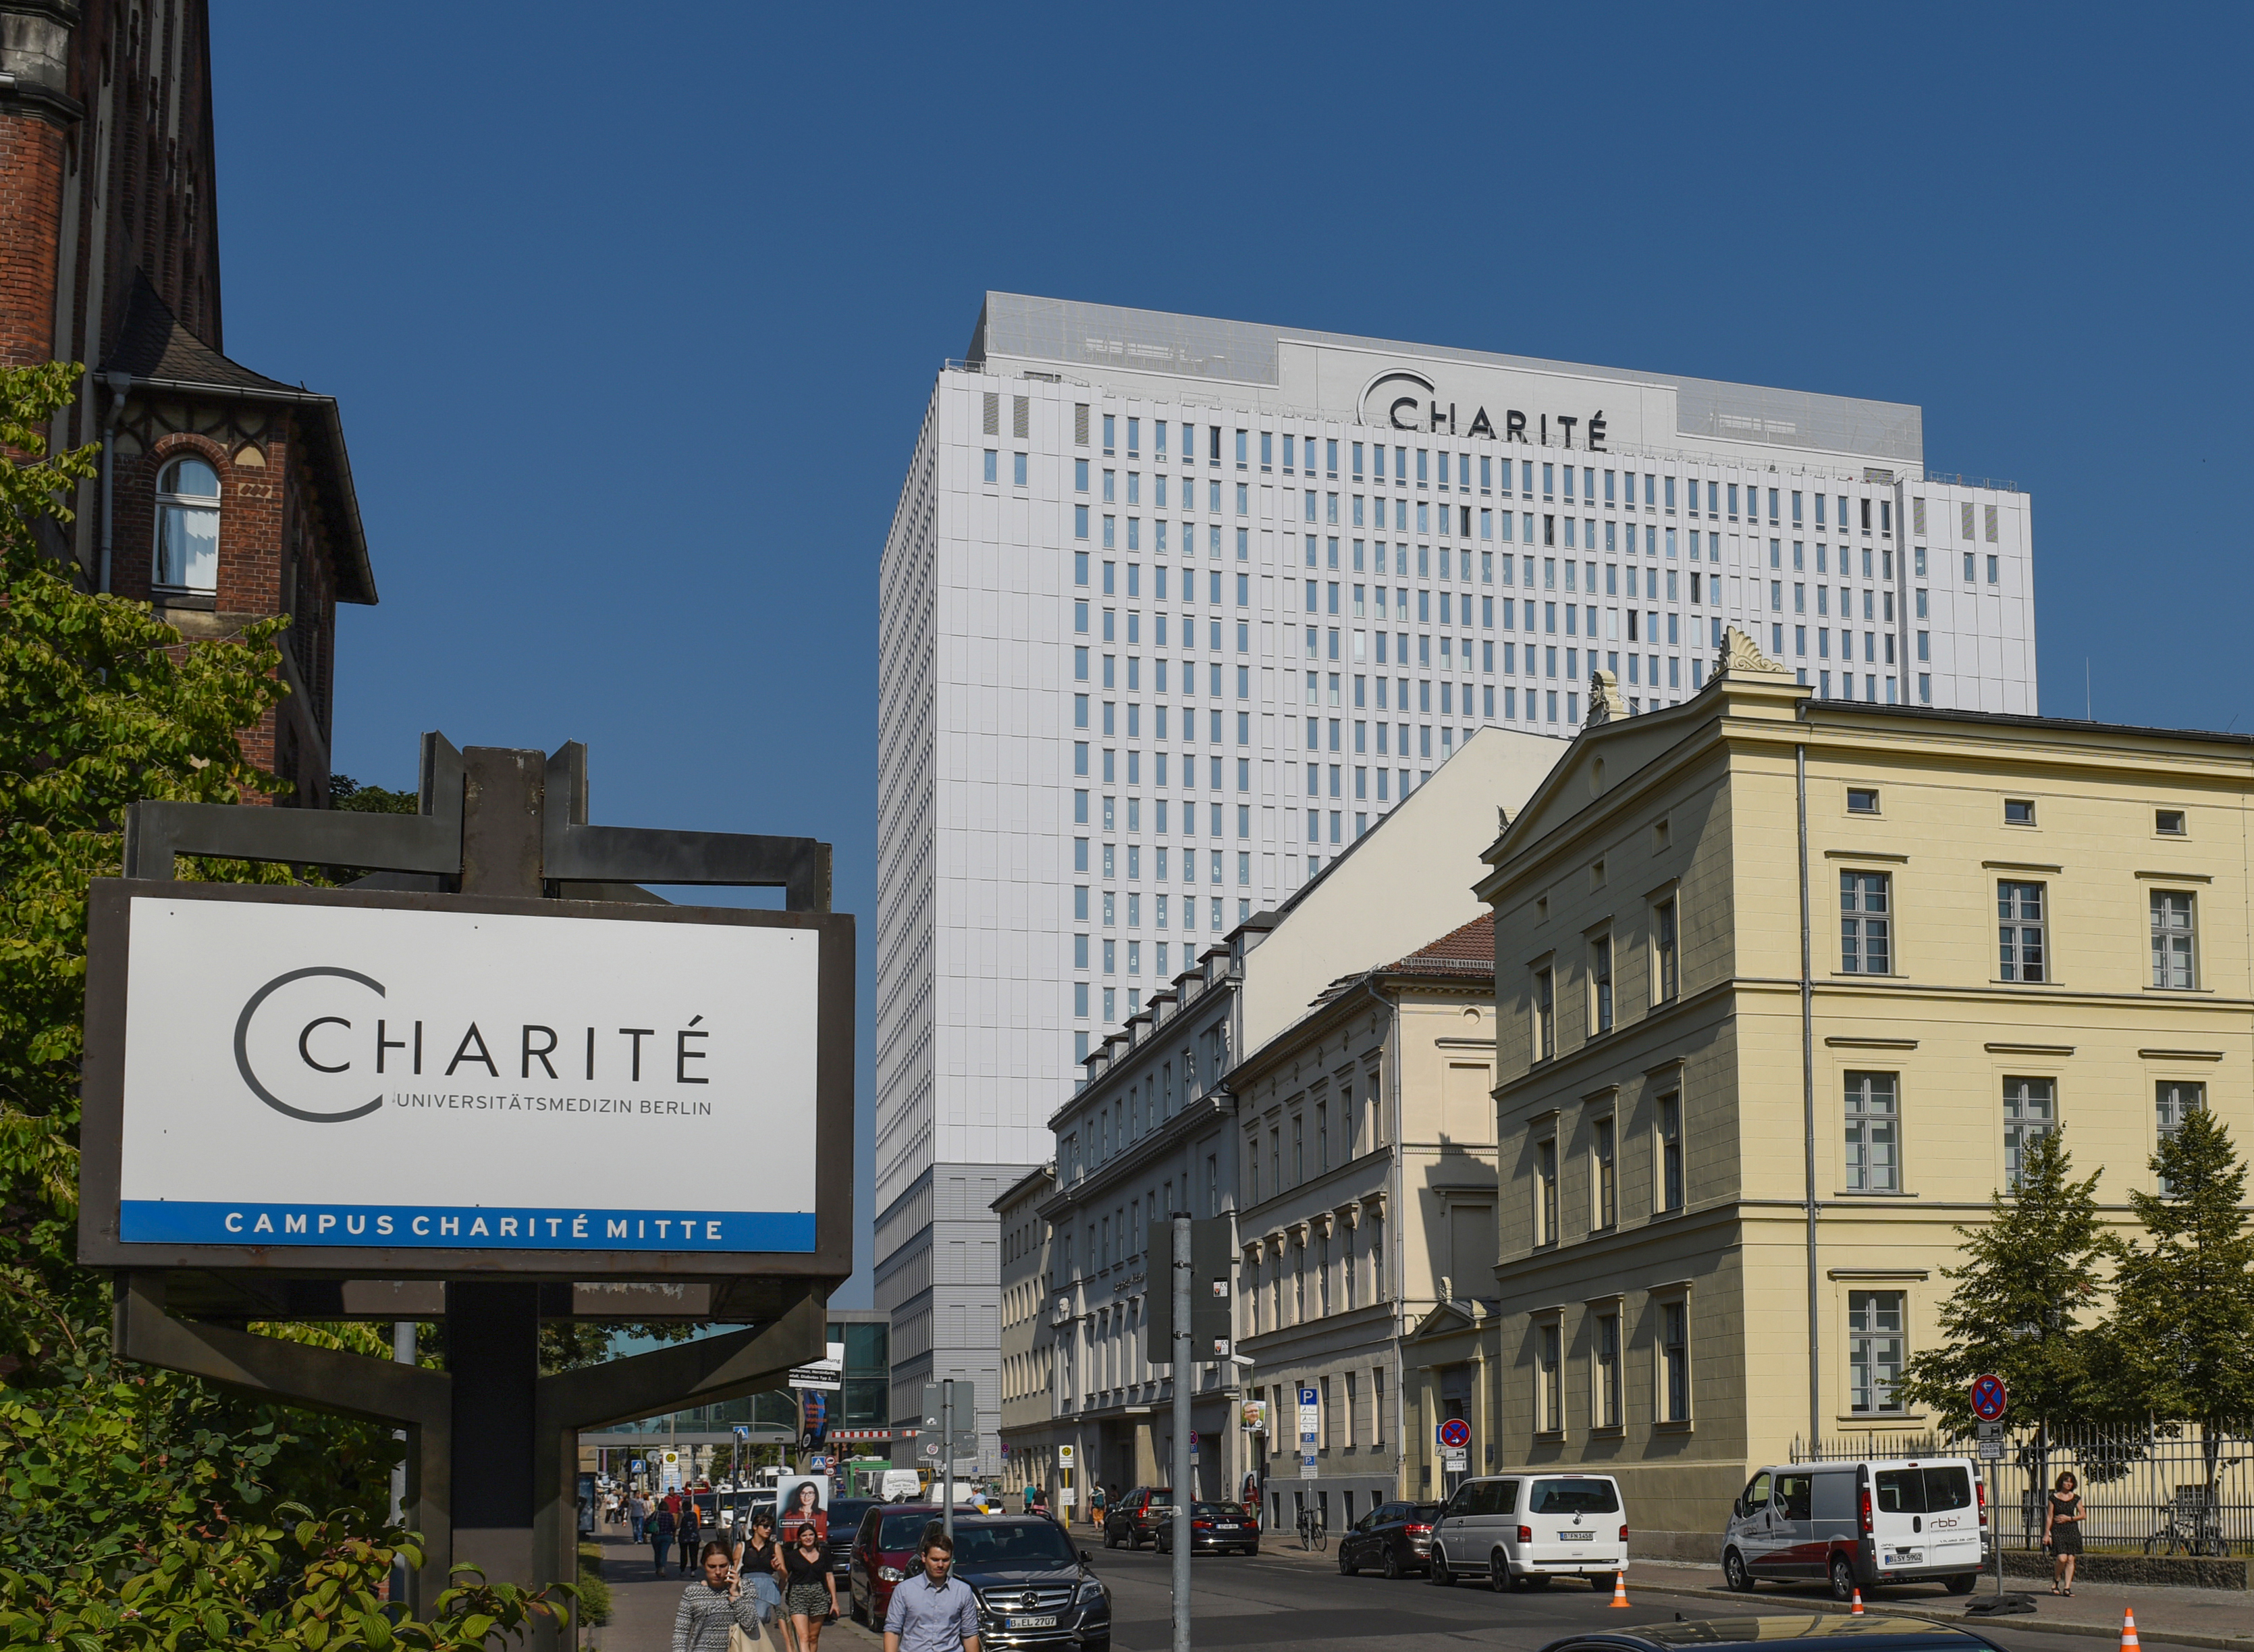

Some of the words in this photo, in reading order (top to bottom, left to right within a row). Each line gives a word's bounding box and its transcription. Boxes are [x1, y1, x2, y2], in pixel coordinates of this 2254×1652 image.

[1389, 396, 1608, 453] CHARITÉ
[298, 1014, 709, 1084] CHARITÉ
[397, 1092, 631, 1113] UNIVERSITÄTSMEDIZIN
[640, 1100, 711, 1115] BERLIN
[225, 1213, 393, 1235] CAMPUS
[412, 1213, 588, 1238] CHARITÉ
[608, 1219, 722, 1240] MITTE
[1304, 1390, 1313, 1403] P
[1305, 1434, 1312, 1442] P
[1305, 1457, 1312, 1465] P
[1930, 1517, 1957, 1528] rbb
[1035, 1617, 1055, 1626] 2707
